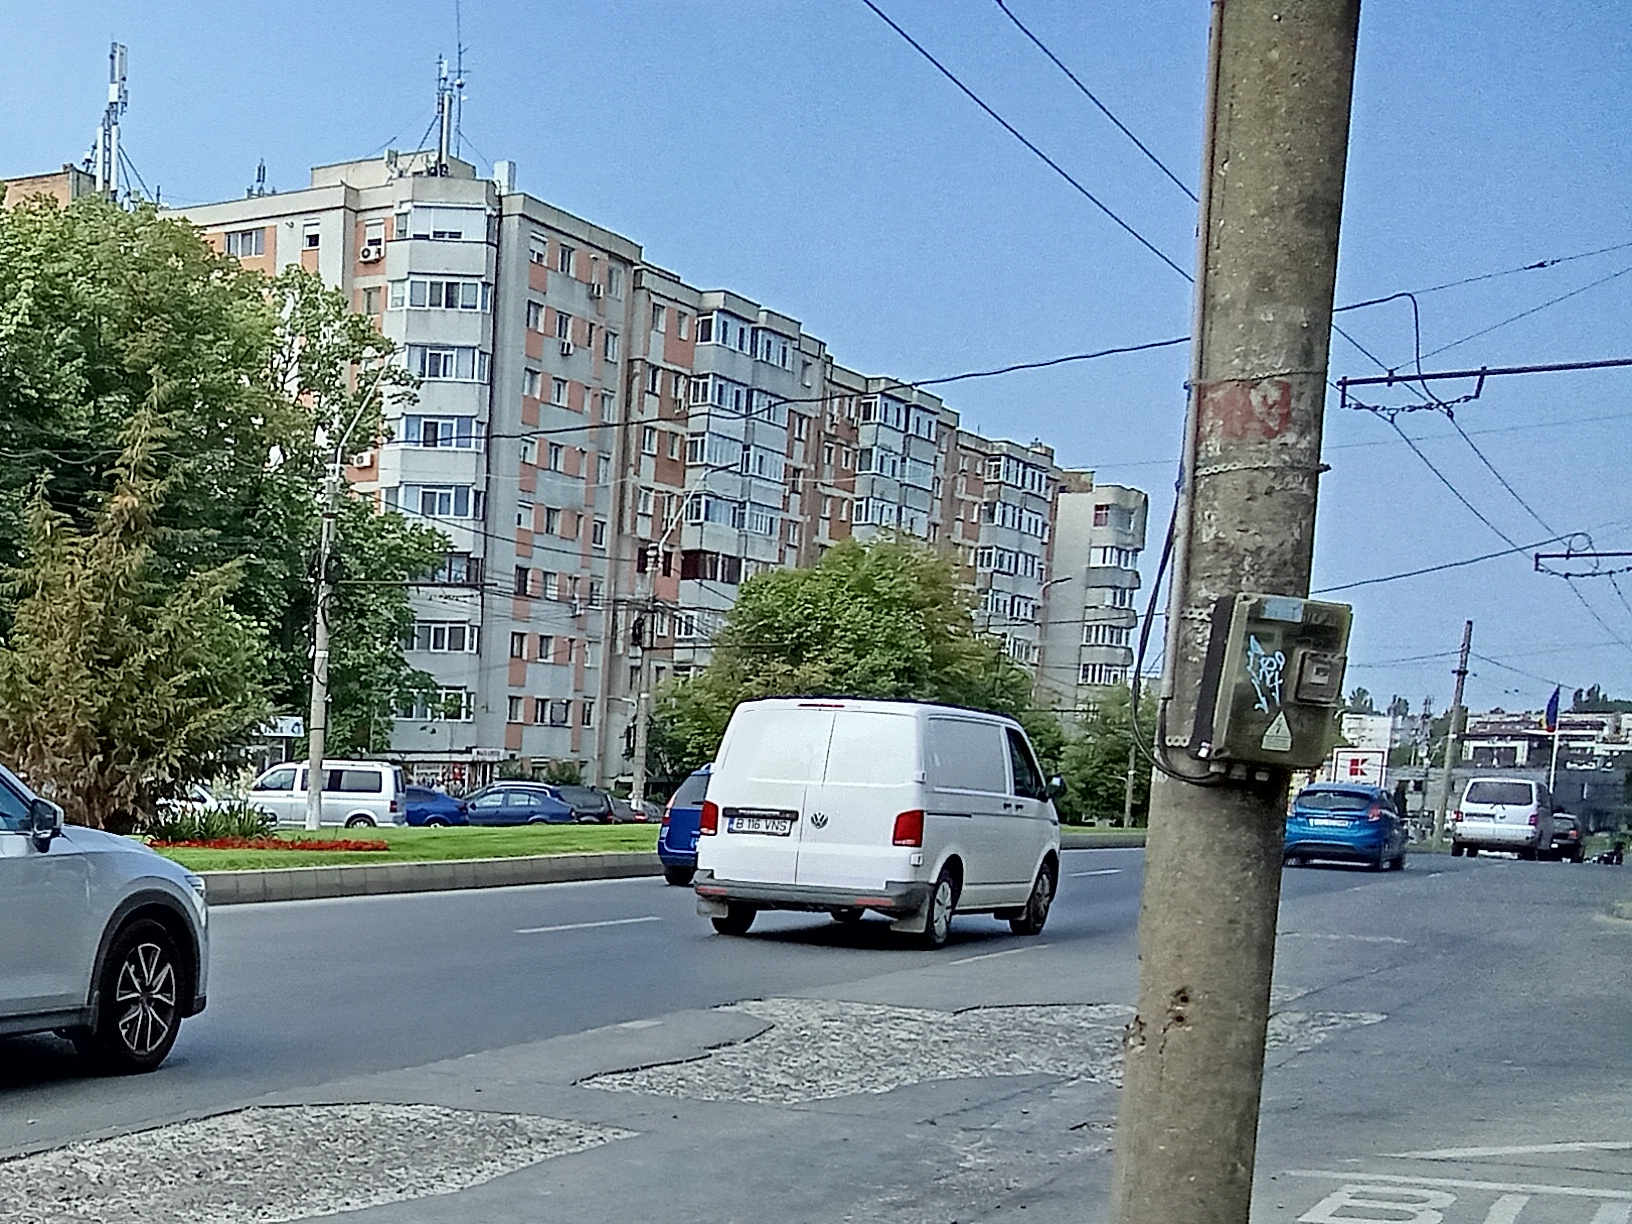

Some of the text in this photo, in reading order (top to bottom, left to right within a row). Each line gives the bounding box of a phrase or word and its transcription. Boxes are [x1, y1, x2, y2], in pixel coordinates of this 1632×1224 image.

[735, 818, 788, 831] B 116 VNS
